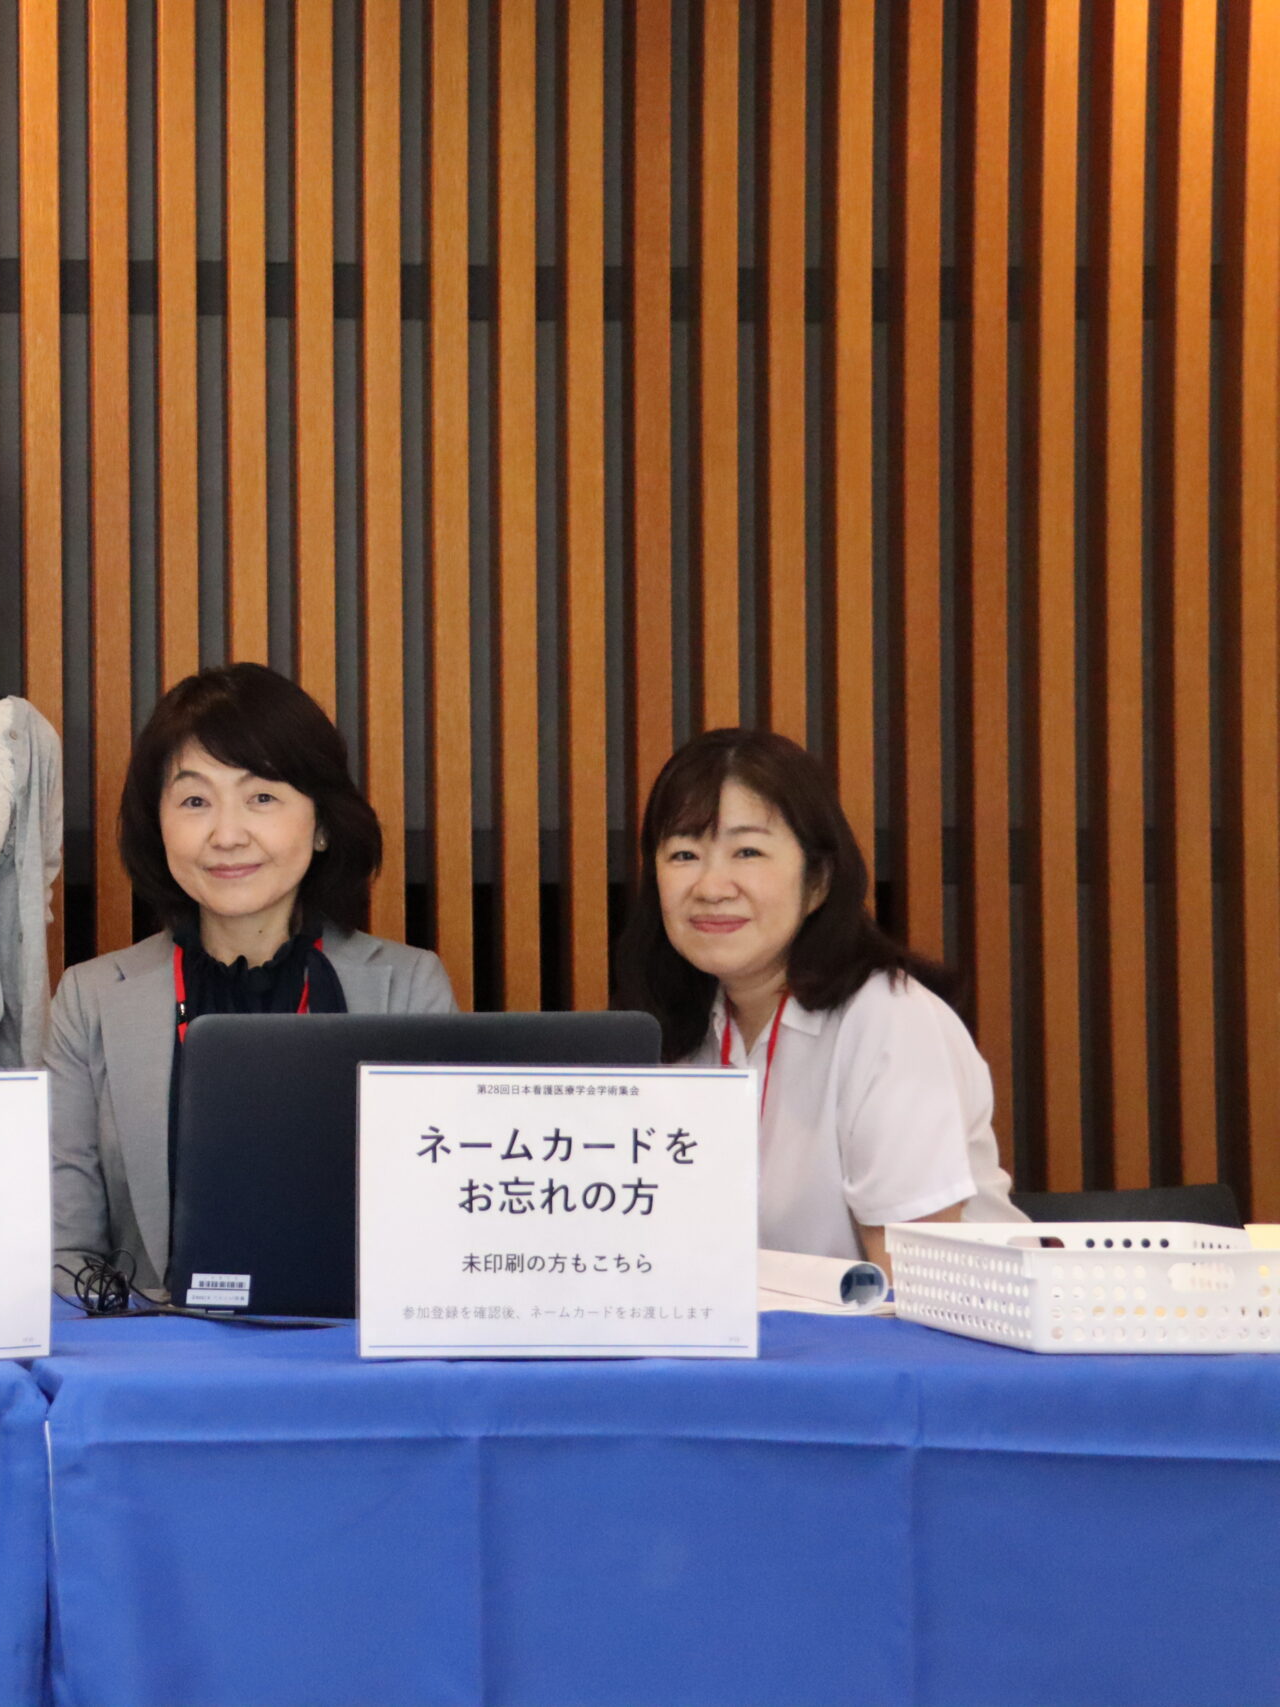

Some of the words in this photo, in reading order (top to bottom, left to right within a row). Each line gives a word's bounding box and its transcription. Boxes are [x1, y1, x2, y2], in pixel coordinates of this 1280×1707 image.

[476, 1084, 640, 1097] 第28回日本看護医療学会学術集会
[416, 1125, 698, 1165] ネームカードを
[457, 1176, 659, 1216] お忘れの方
[461, 1253, 653, 1275] 未印刷の方もこちら
[402, 1305, 713, 1321] 参加登録を確認後、ネームカードをお渡しします
